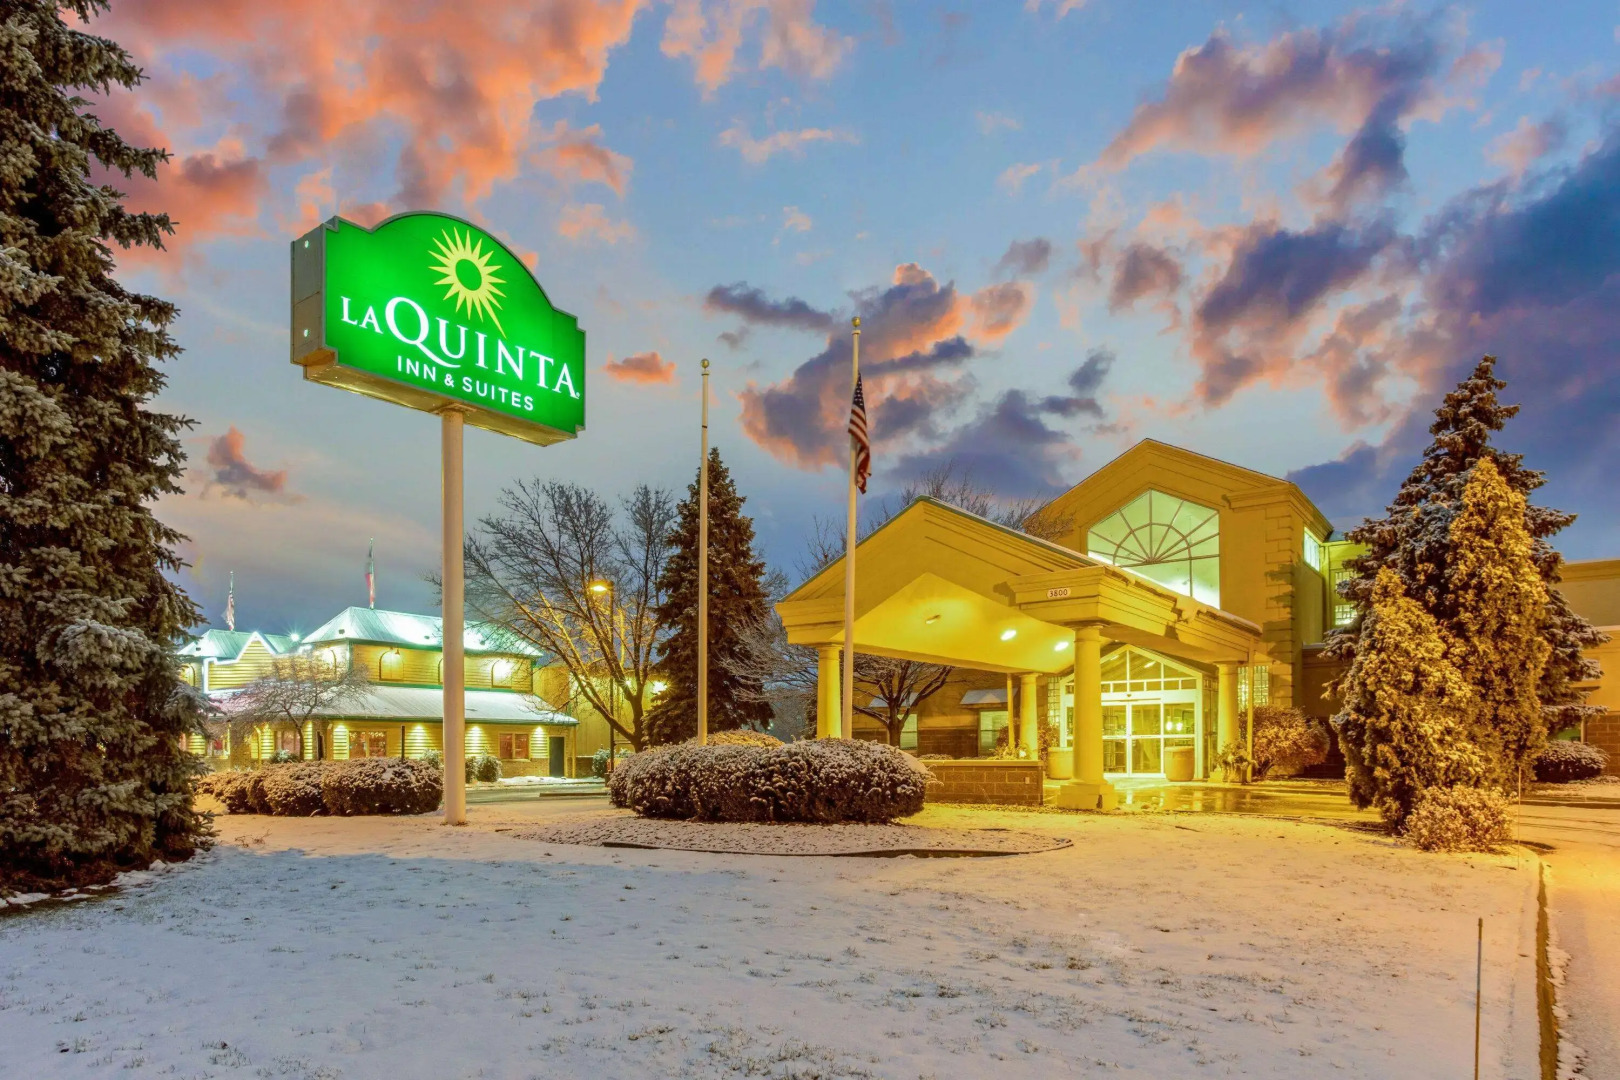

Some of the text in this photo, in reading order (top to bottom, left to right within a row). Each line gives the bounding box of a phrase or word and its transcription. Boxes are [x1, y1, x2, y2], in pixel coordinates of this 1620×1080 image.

[341, 296, 580, 399] LA QUINTA
[397, 355, 534, 411] INN & SUITES
[1049, 589, 1068, 598] 3800
